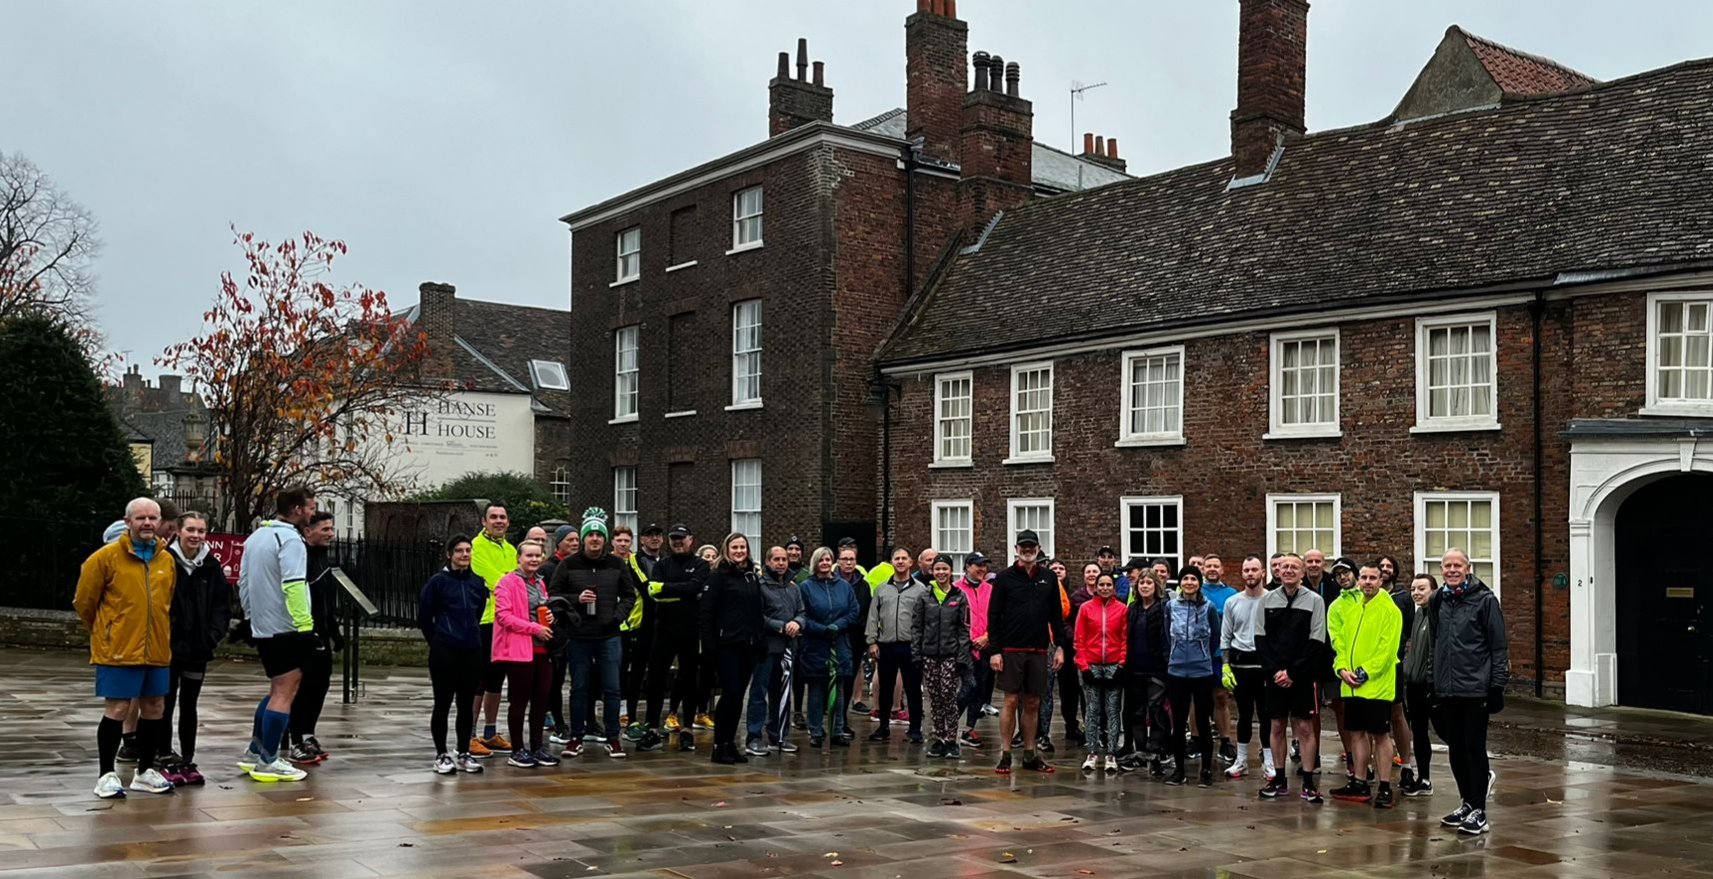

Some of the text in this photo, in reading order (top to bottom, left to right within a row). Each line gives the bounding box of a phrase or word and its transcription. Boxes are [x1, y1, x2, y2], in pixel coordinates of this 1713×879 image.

[438, 401, 496, 417] HANSE
[402, 411, 429, 435] H
[437, 424, 496, 439] HOUSE
[1577, 579, 1583, 587] 2
